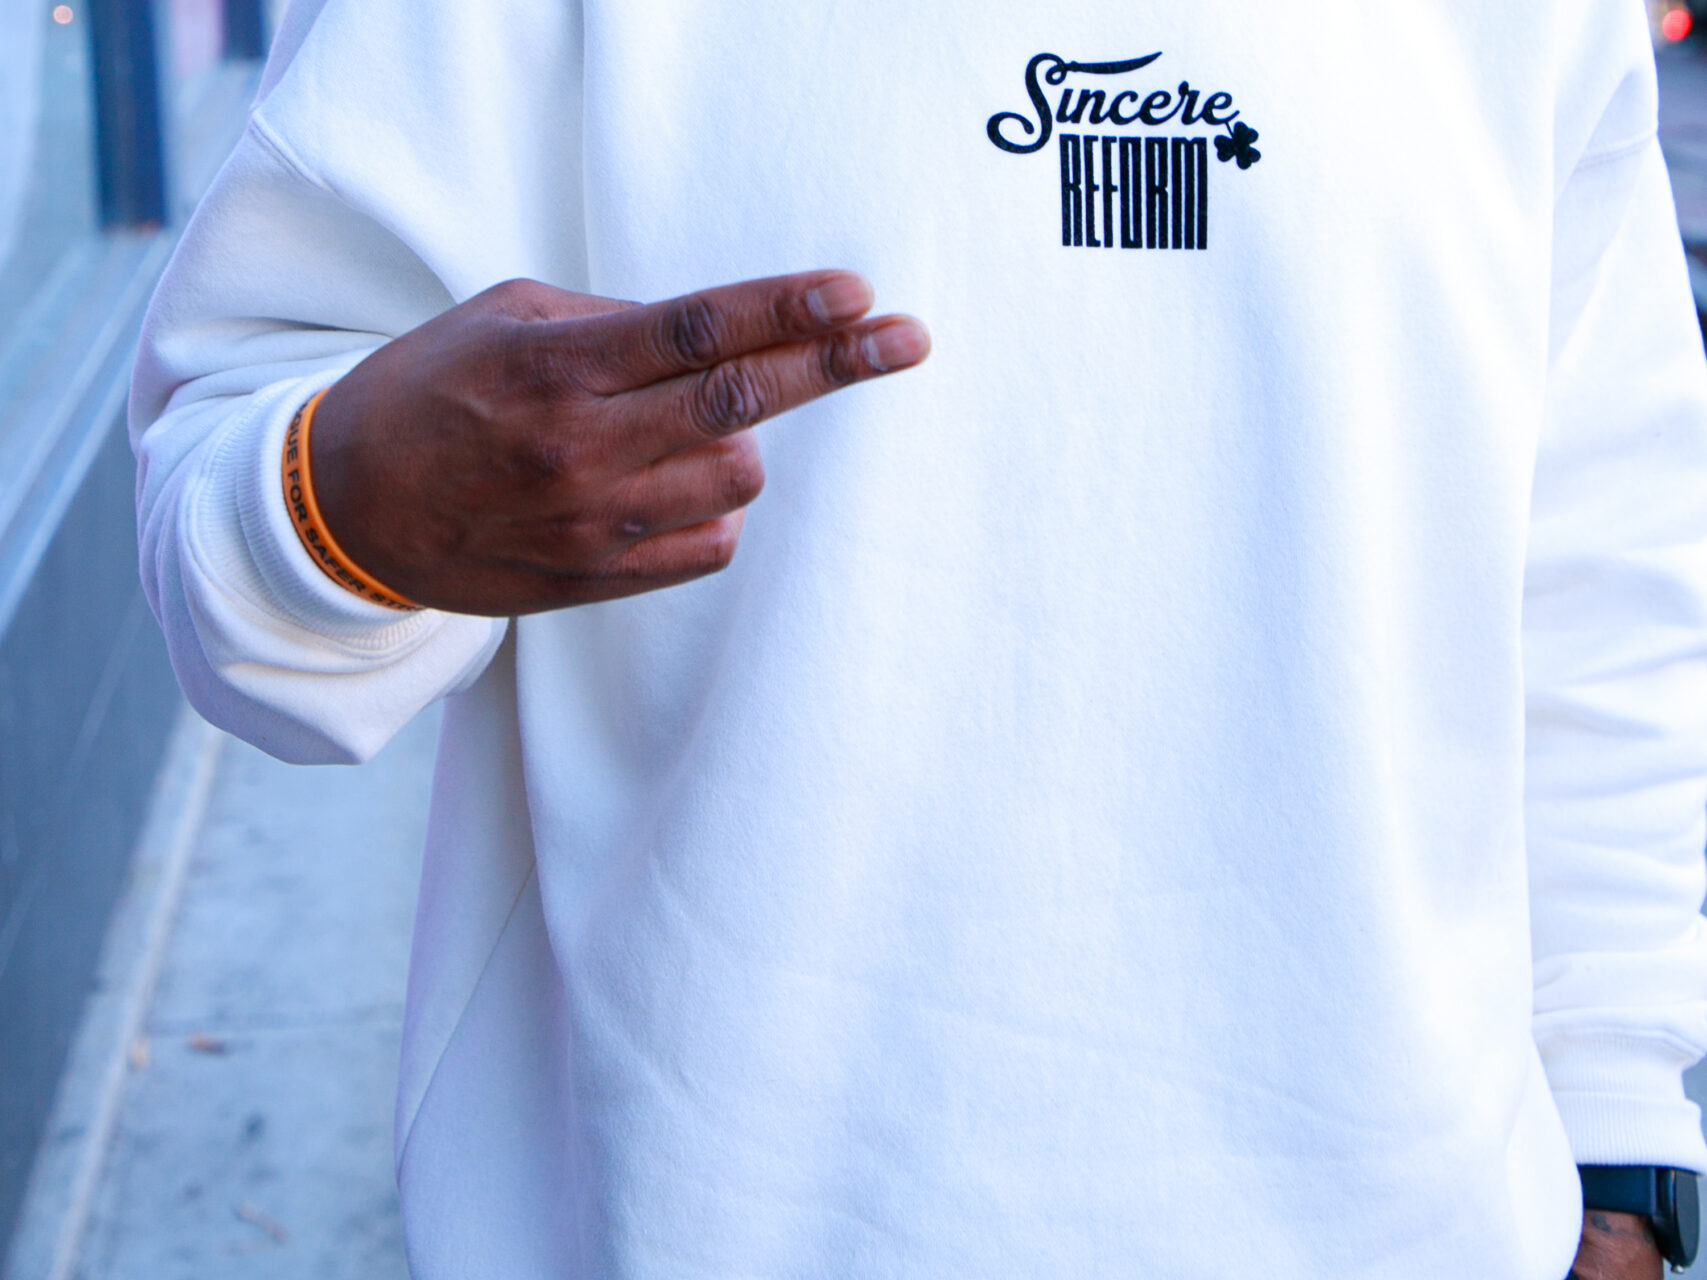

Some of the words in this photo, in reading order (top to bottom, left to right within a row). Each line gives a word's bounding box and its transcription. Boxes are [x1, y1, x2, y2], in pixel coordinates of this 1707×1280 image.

[986, 51, 1240, 154] Sincere
[1059, 133, 1208, 250] REFORM
[287, 469, 308, 522] FOR
[305, 527, 366, 592] SAFER
